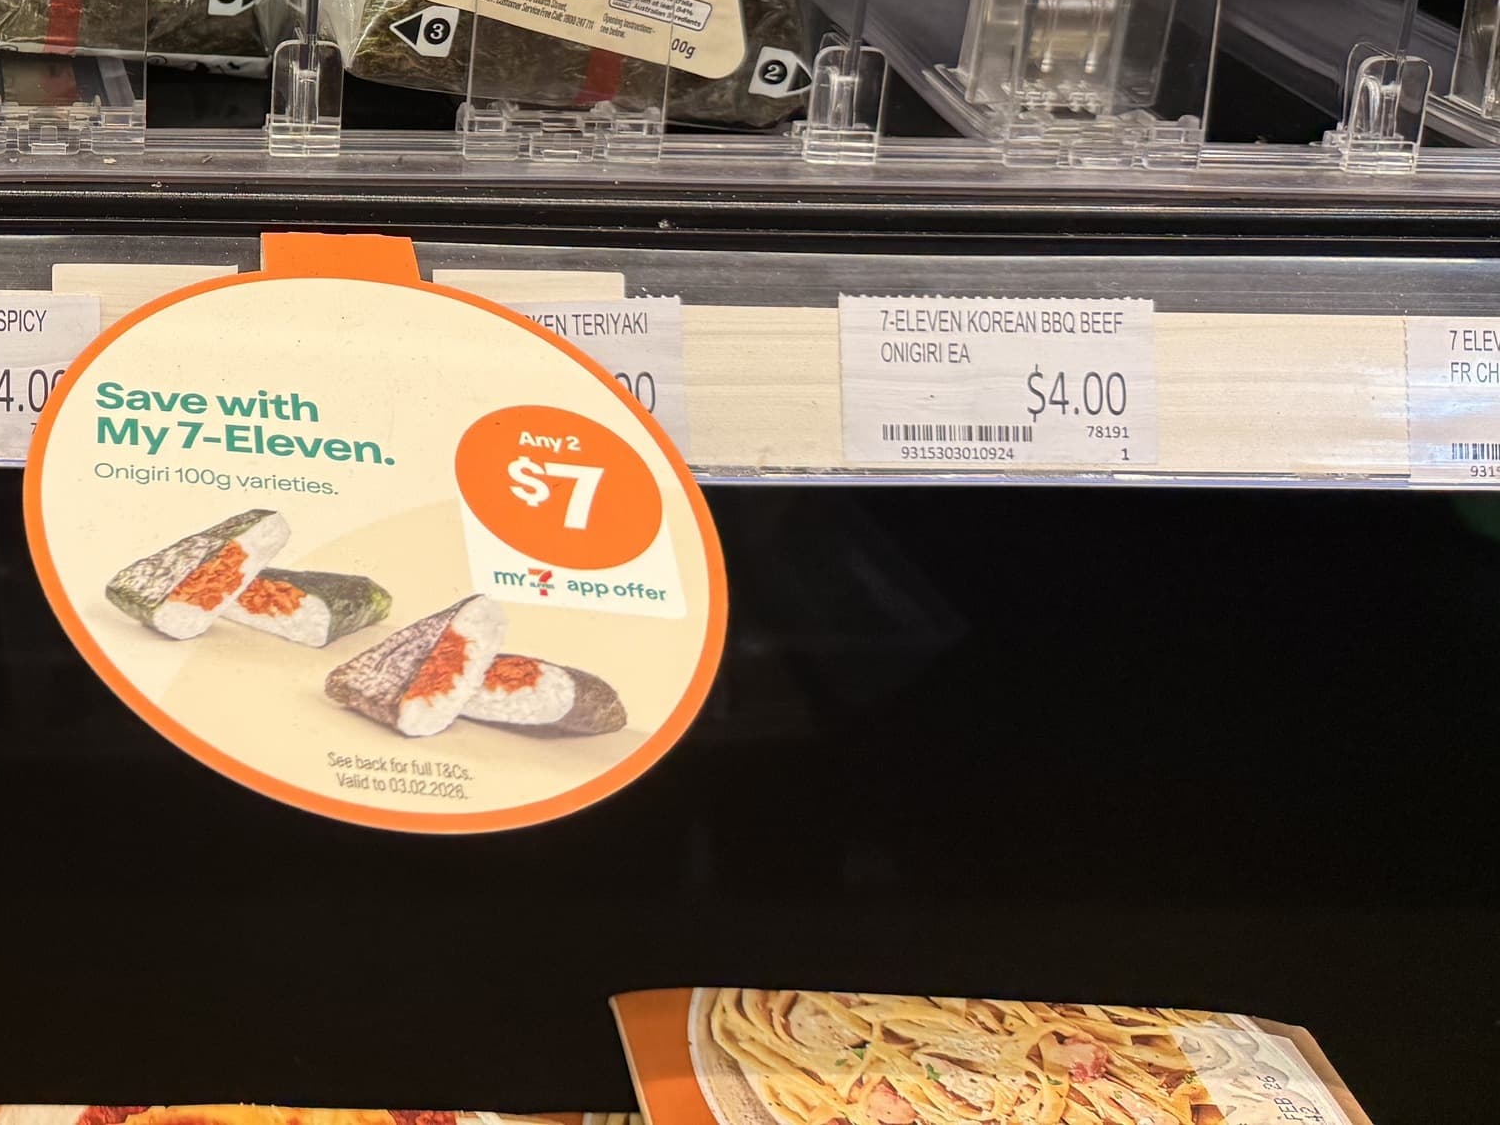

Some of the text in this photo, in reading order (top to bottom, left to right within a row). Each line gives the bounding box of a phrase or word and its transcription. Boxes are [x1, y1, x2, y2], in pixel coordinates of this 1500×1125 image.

[572, 312, 648, 336] TERIYAKI
[880, 310, 1123, 334] 7-ELEVEN KOREAN BBQ BEEF
[881, 342, 971, 364] ONIGIRI EA
[1449, 330, 1500, 352] 7 ELEV
[1450, 362, 1471, 383] FR
[96, 381, 319, 423] Save with
[1026, 364, 1127, 422] $4.00
[96, 416, 396, 466] My 7-Eleven.
[518, 431, 581, 453] Any 2
[1085, 426, 1130, 439] 78191
[901, 447, 1014, 460] 9315303010924
[1120, 448, 1130, 461] 1
[94, 461, 339, 496] Onigiri 100g varieties.
[507, 455, 605, 531] $7
[493, 570, 527, 588] my
[567, 579, 609, 598] app
[614, 581, 667, 602] offer
[327, 751, 353, 769] See
[355, 755, 387, 772] back
[390, 757, 407, 774] for
[411, 760, 432, 777] full
[336, 772, 370, 790] Valid
[373, 777, 386, 792] to
